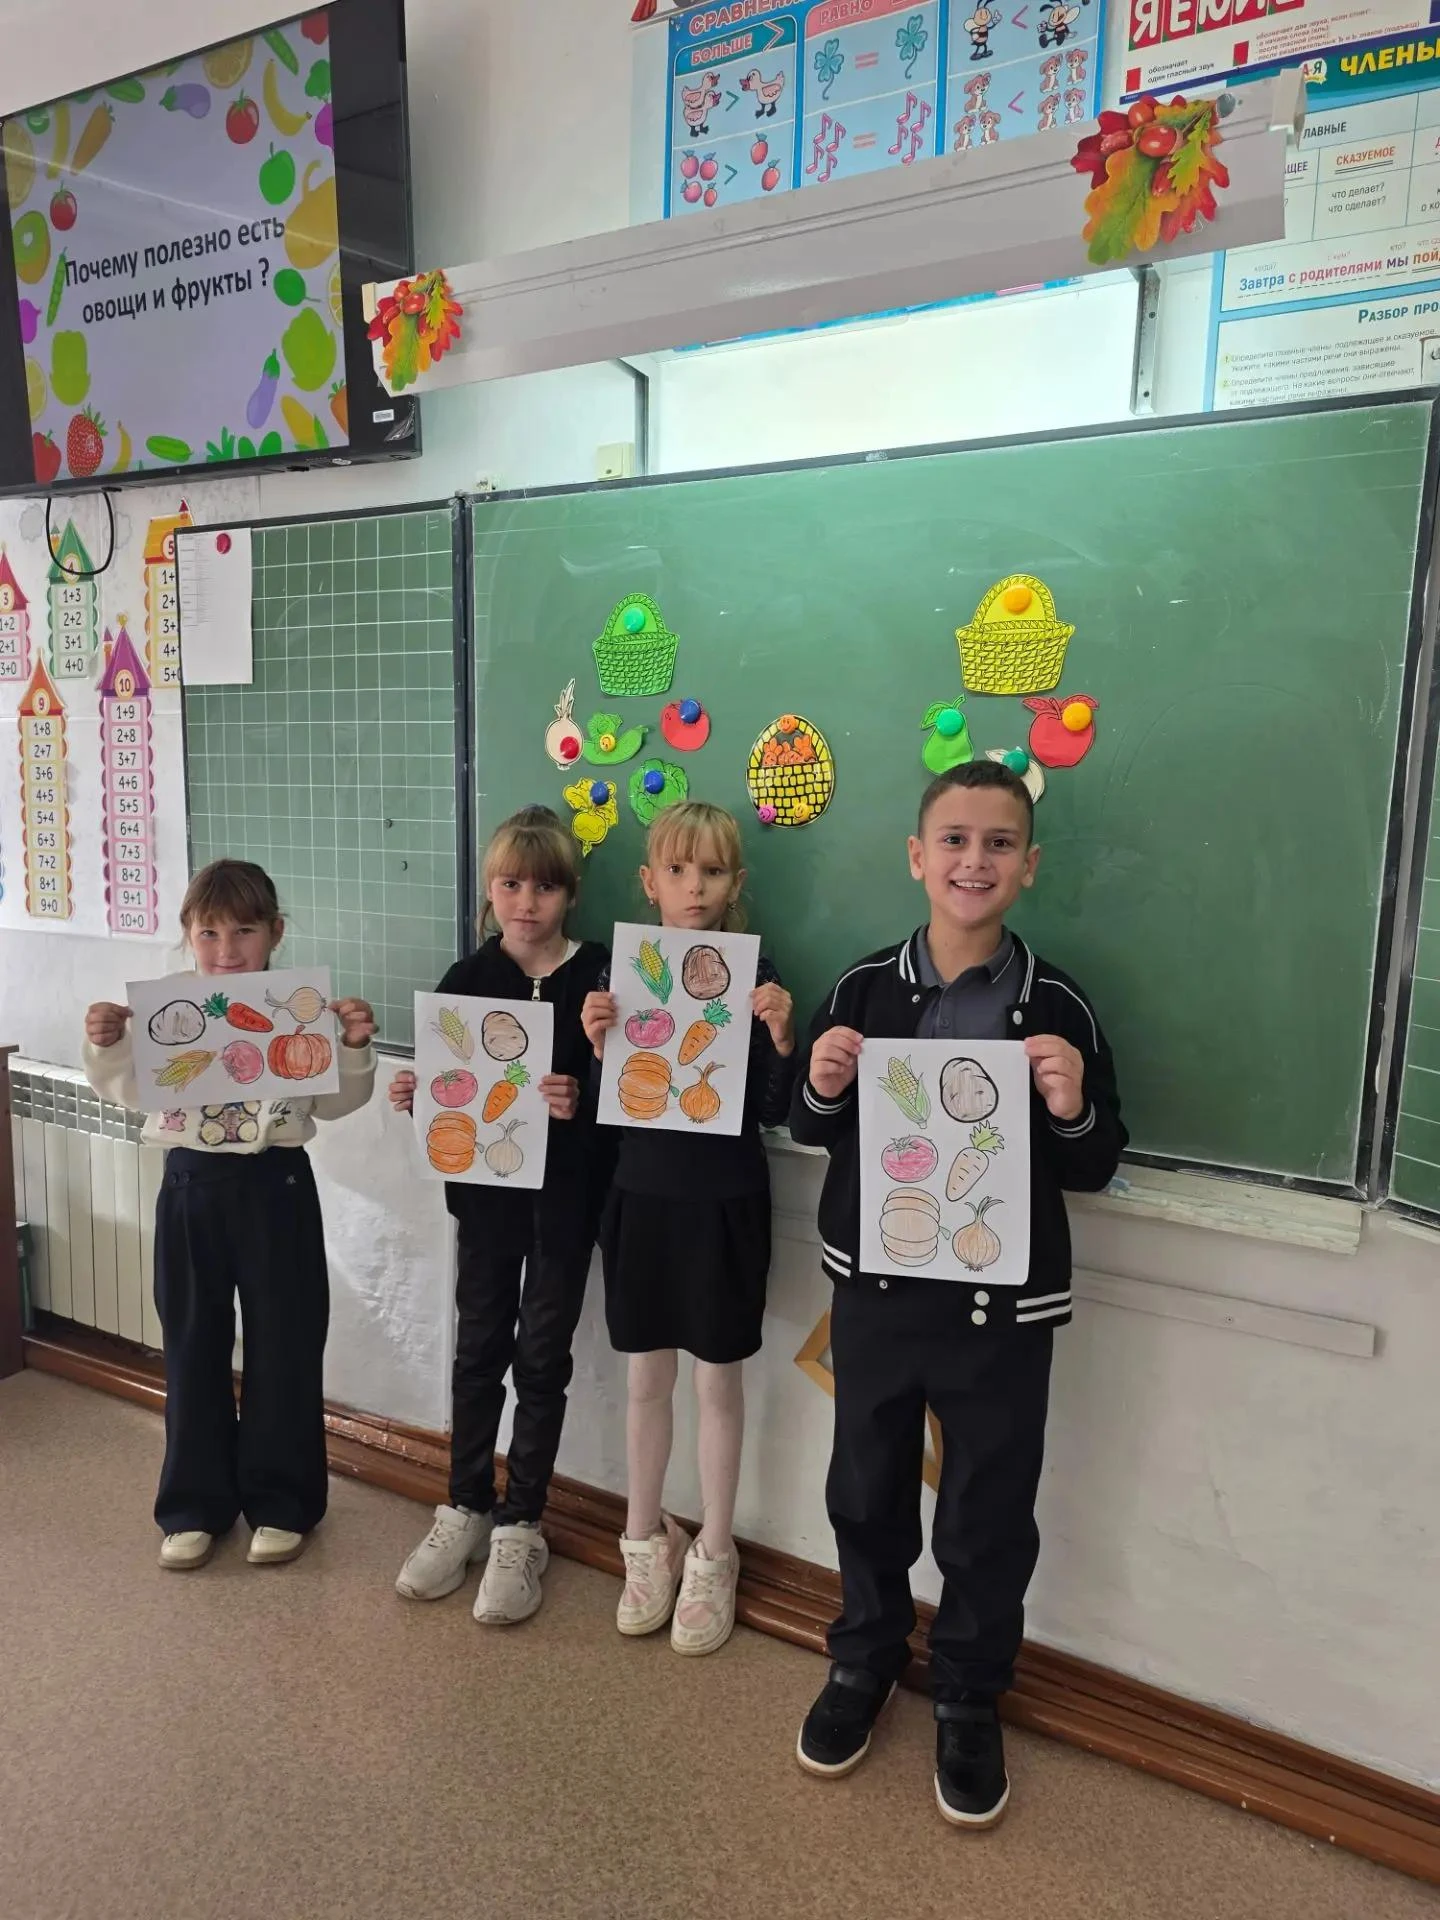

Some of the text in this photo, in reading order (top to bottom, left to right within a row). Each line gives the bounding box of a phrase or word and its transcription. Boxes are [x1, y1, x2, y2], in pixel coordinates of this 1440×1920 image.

[820, 0, 873, 24] РАВНО
[691, 33, 753, 65] БОЛЬШЕ
[1341, 38, 1440, 76] ЧЛЕНЫ
[1148, 60, 1188, 74] обозначает
[1166, 66, 1197, 80] гласный
[1303, 122, 1347, 139] ЛАВНЫЕ
[1336, 146, 1396, 166] СКАЗУЕМОЕ
[1332, 182, 1385, 199] что делает?
[1328, 196, 1386, 213] что сделает?
[1429, 201, 1440, 210] ко
[65, 217, 285, 286] Почему полезно есть
[1240, 248, 1440, 292] Завтра с родителями мы пой
[83, 257, 270, 324] овощи и фрукты ?
[1413, 302, 1440, 315] ПРО
[167, 539, 174, 556] 5
[162, 567, 177, 585] 1+
[3, 592, 9, 606] 3
[63, 588, 81, 603] 1+3
[162, 591, 178, 609] 2+
[63, 611, 82, 627] 2+2
[163, 618, 176, 634] 3+
[0, 639, 15, 654] 2+1
[64, 635, 82, 650] 3+1
[163, 642, 177, 658] 4+
[0, 661, 17, 676] 3+0
[65, 657, 84, 672] 4+0
[119, 679, 133, 693] 10
[38, 697, 45, 711] 9
[116, 704, 135, 720] 1+9
[33, 721, 51, 736] 1+8
[117, 728, 136, 743] 2+8
[34, 744, 52, 758] 2+7
[118, 752, 136, 766] 3+7
[35, 766, 53, 781] 3+6
[118, 775, 138, 790] 4+6
[36, 789, 54, 803] 4+5
[119, 798, 139, 813] 5+5
[37, 810, 54, 825] 5+4
[120, 821, 139, 836] 6+4
[37, 833, 55, 847] 6+3
[120, 844, 140, 860] 7+3
[38, 854, 56, 869] 7+2
[122, 867, 141, 883] 8+2
[39, 876, 56, 891] 8+1
[123, 890, 141, 905] 9+1
[40, 898, 58, 913] 9+0
[120, 913, 144, 929] 10+0
